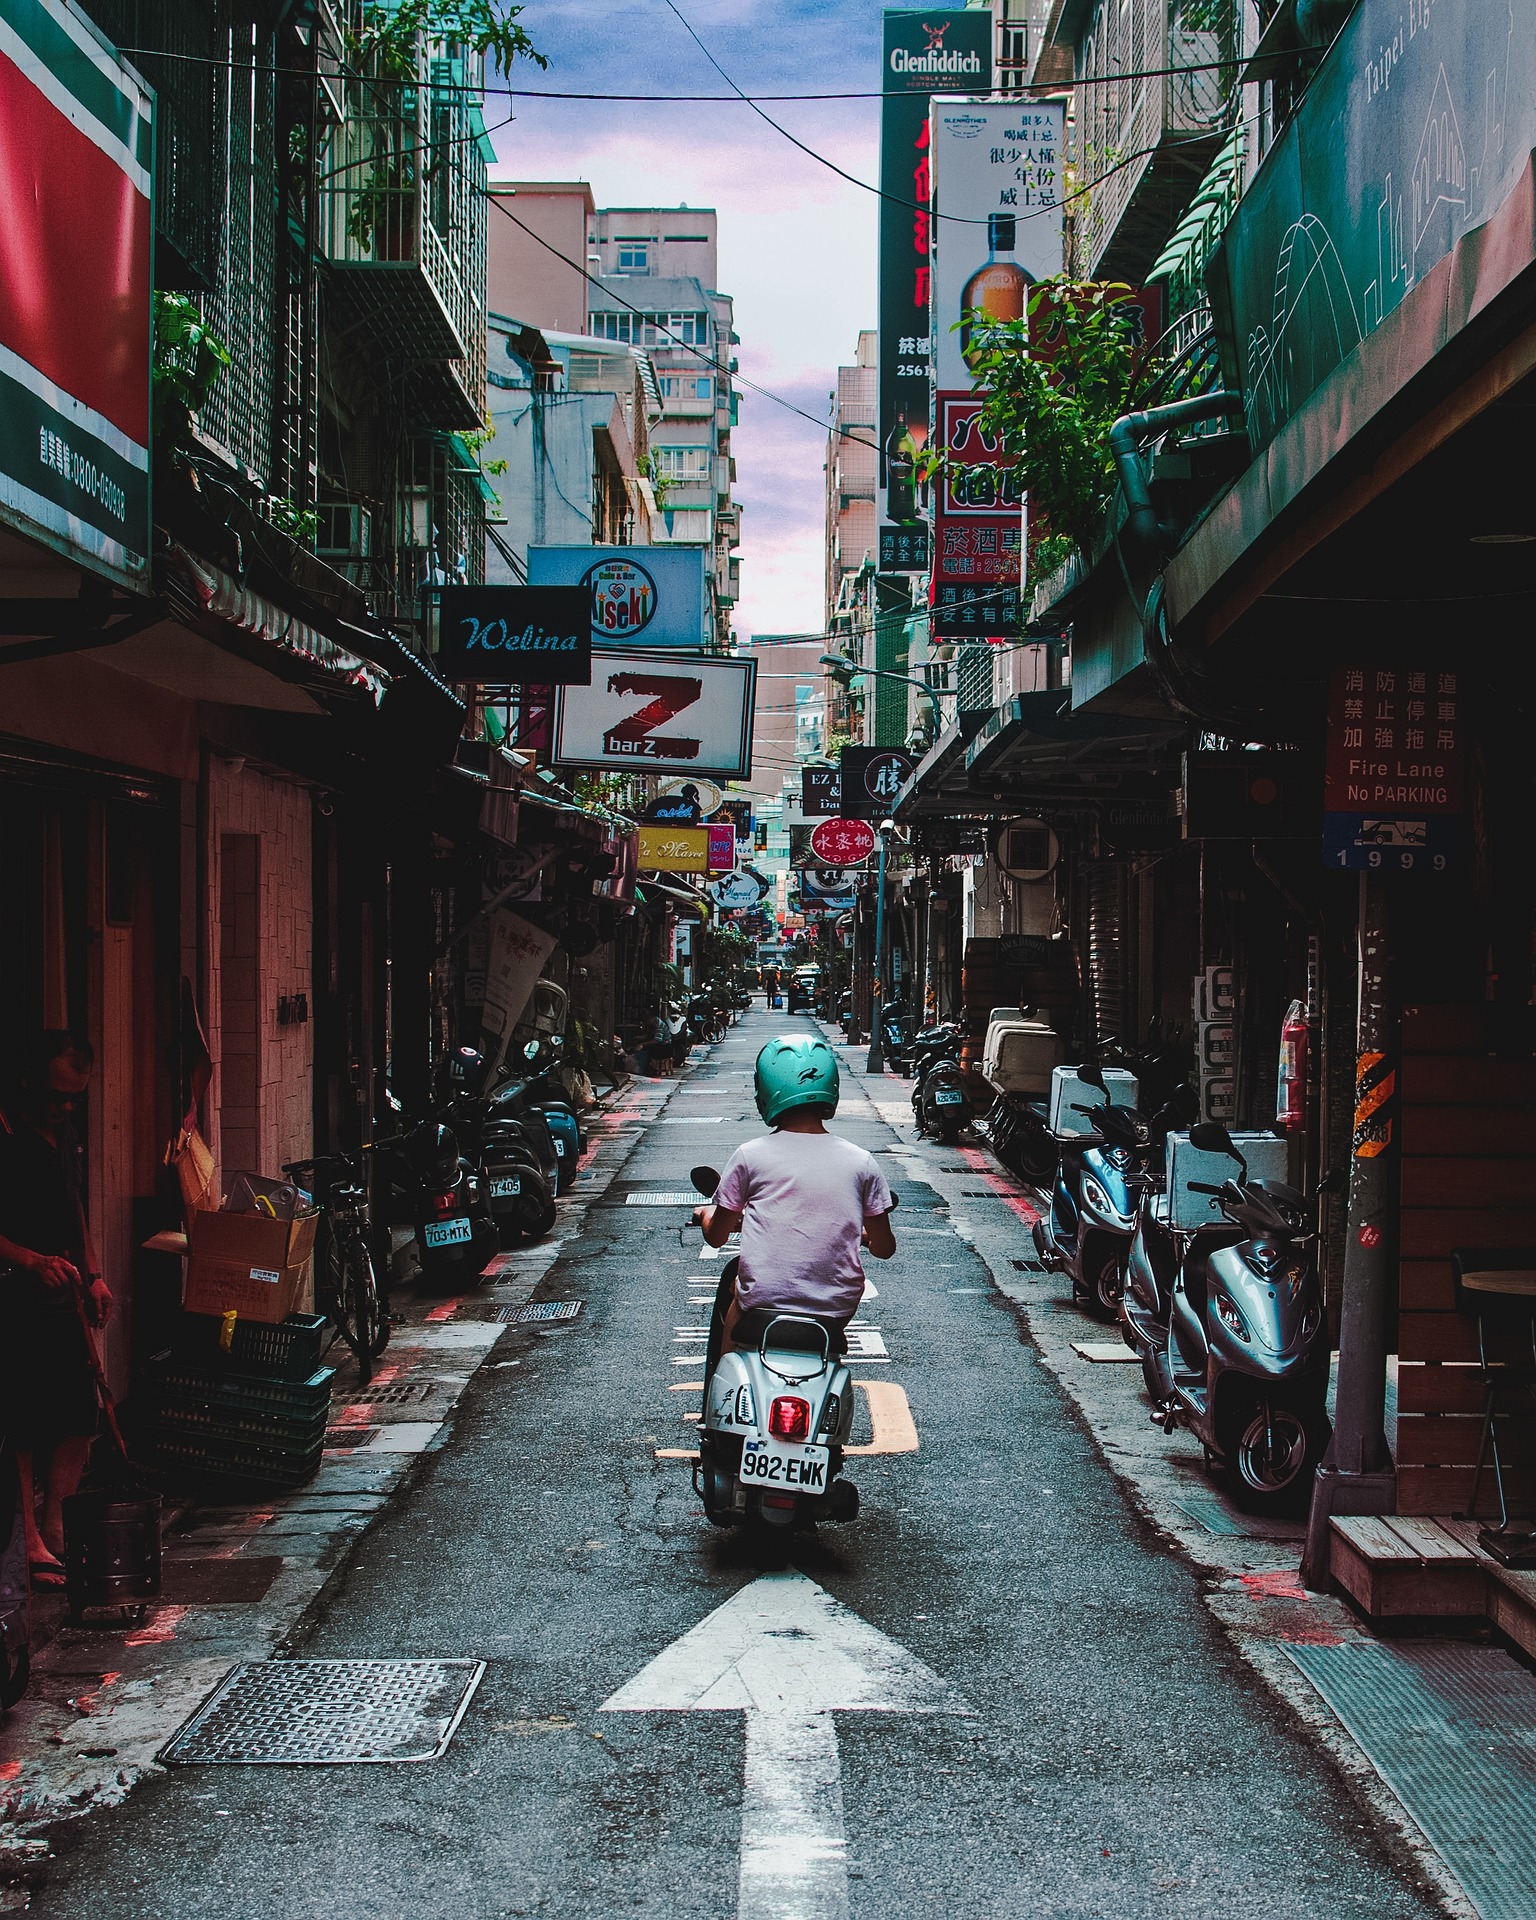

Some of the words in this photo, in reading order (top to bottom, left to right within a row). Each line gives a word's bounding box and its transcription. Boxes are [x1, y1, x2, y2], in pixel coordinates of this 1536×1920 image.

[890, 48, 980, 73] Glenfiddich
[1365, 16, 1404, 103] Taipei
[1021, 116, 1053, 126] 很多人
[1014, 167, 1056, 186] 年份
[999, 188, 1057, 207] 威士忌
[459, 616, 578, 651] Welina
[1345, 670, 1457, 694] 消防通道
[1344, 698, 1456, 722] 禁止停車
[1343, 727, 1455, 750] 加強拖吊
[1349, 759, 1388, 776] Fire
[1397, 761, 1445, 777] Lane
[811, 774, 830, 785] EZ
[1347, 785, 1369, 801] No
[1374, 786, 1448, 804] PARKING
